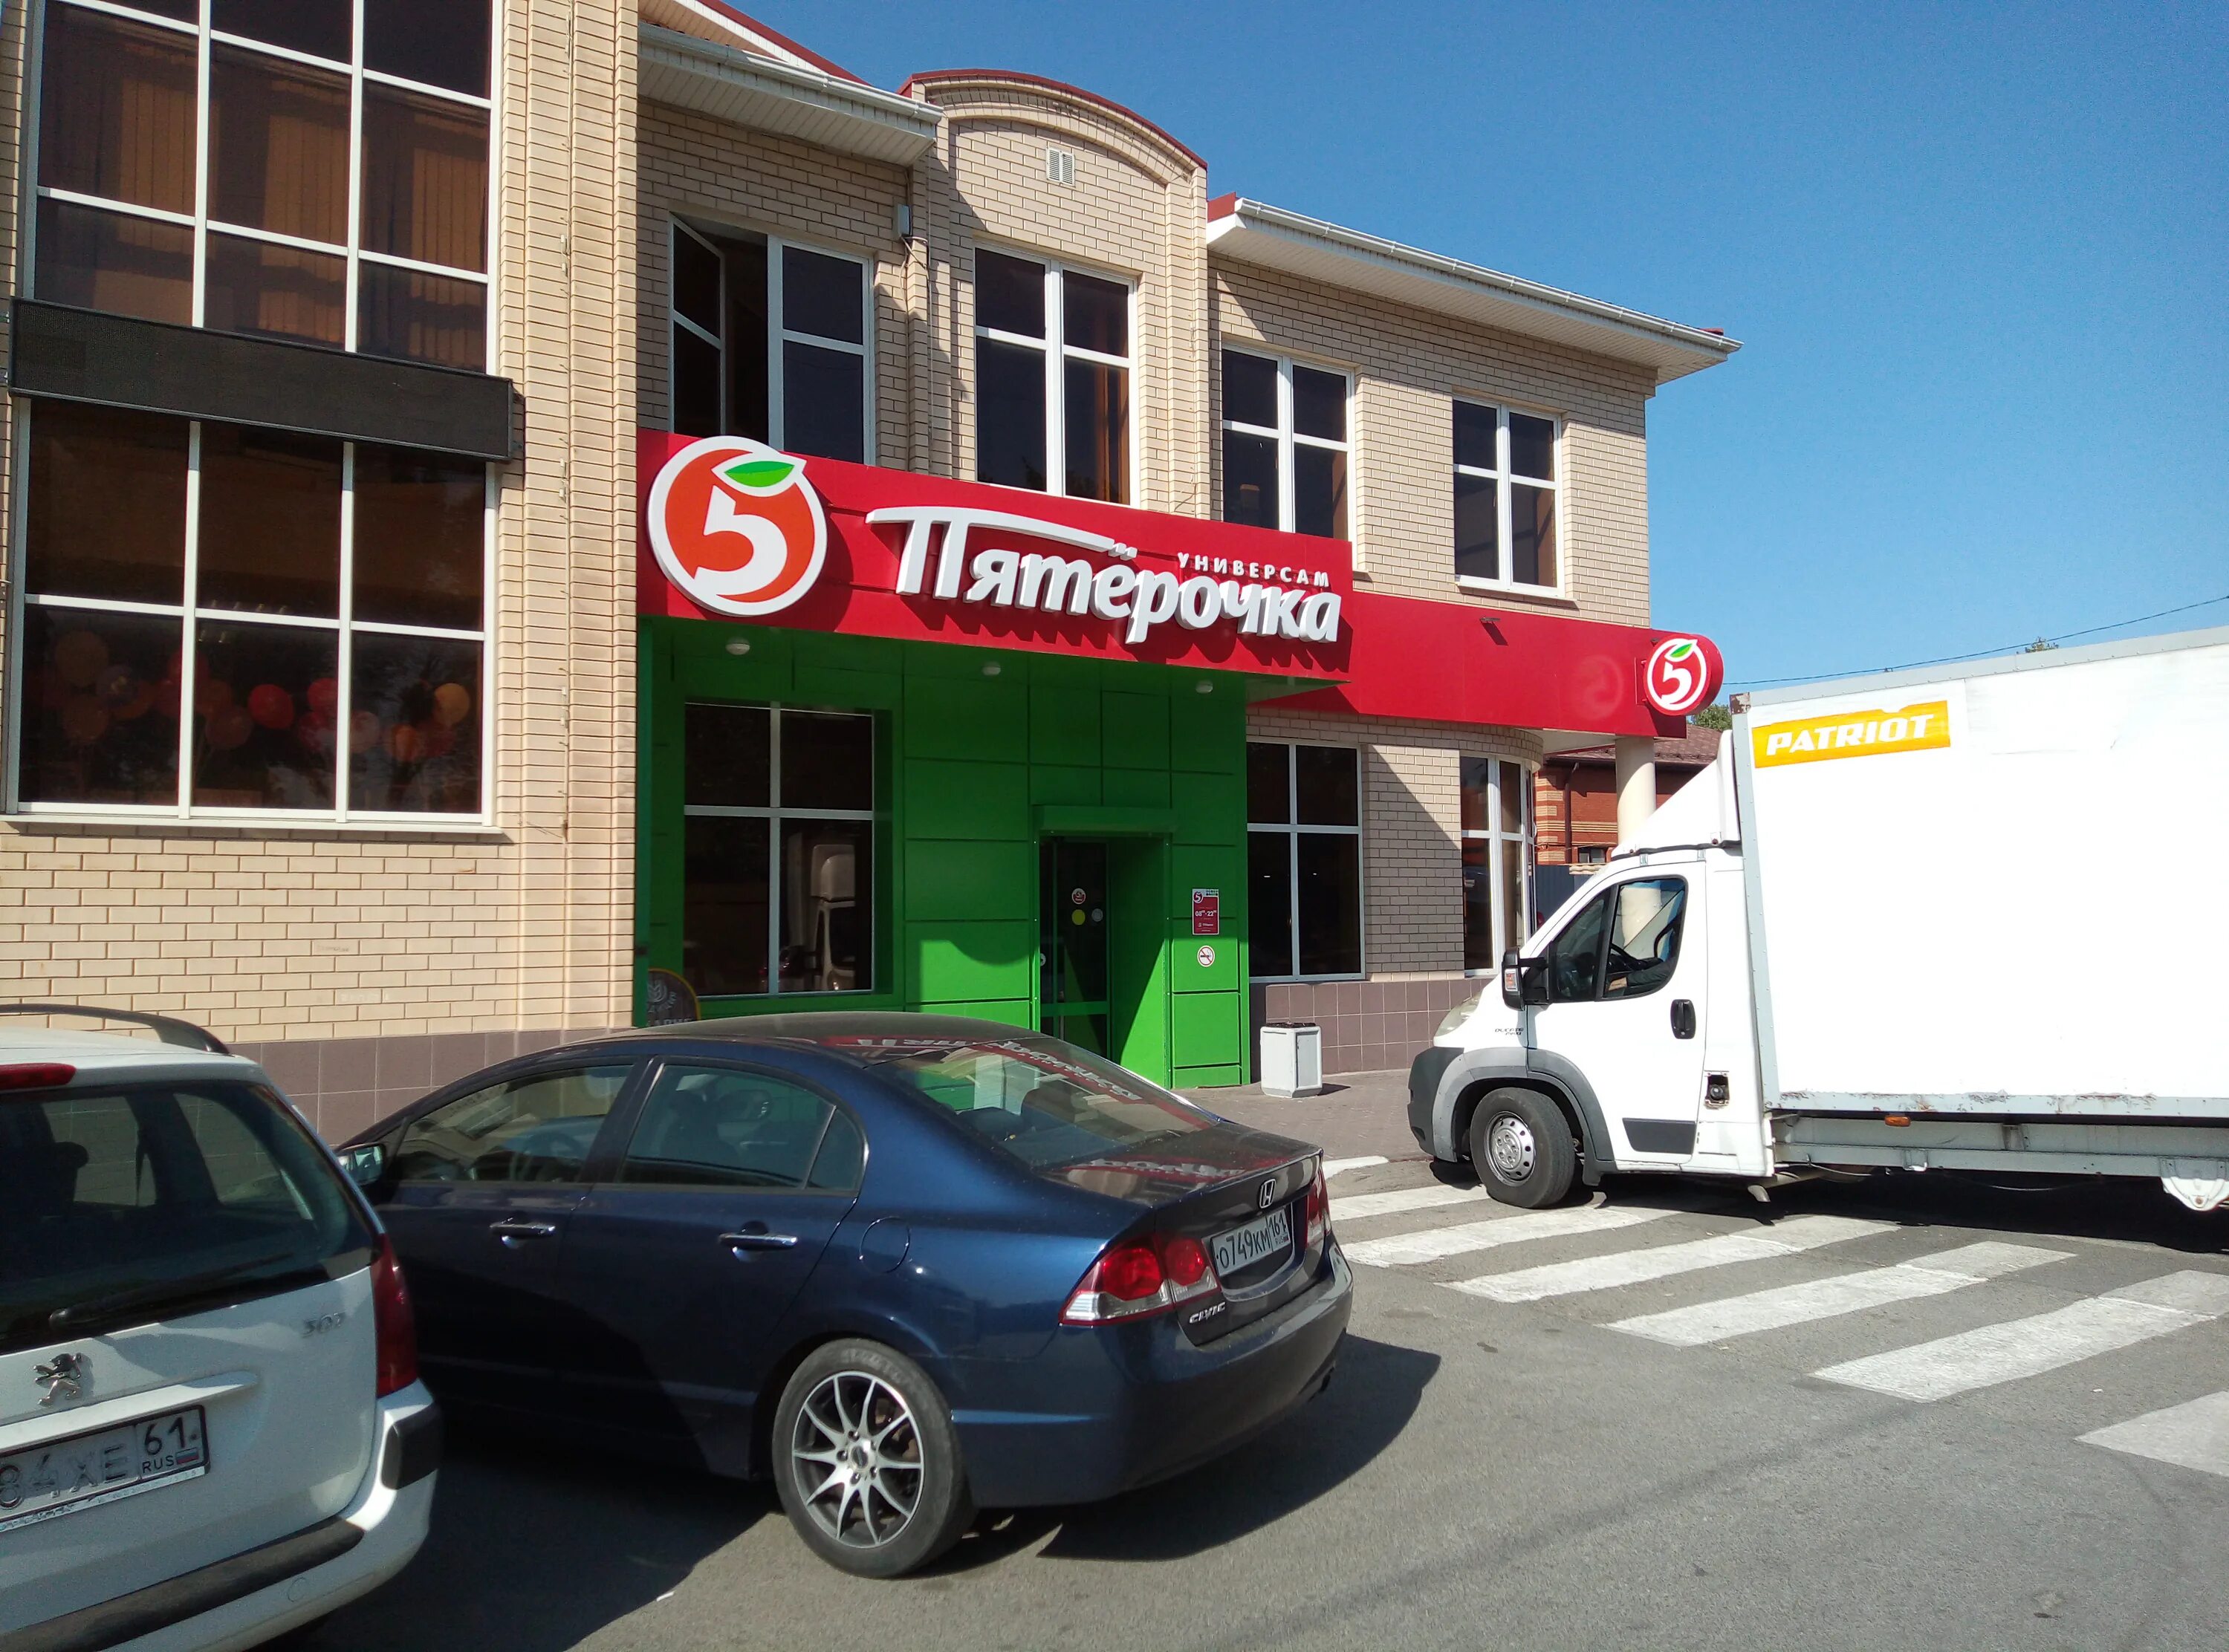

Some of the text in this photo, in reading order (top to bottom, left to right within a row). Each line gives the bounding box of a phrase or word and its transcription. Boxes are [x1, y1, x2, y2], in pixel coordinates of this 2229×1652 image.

[866, 506, 1342, 645] Пятёрочка
[1177, 552, 1329, 588] УНИВЕРСАМ
[1765, 714, 1934, 756] PATRIOT
[1269, 1212, 1286, 1238] 161
[1275, 1235, 1284, 1245] RUS
[1189, 1301, 1226, 1324] CIVIC
[144, 1417, 185, 1455] 61
[142, 1454, 175, 1474] RUS
